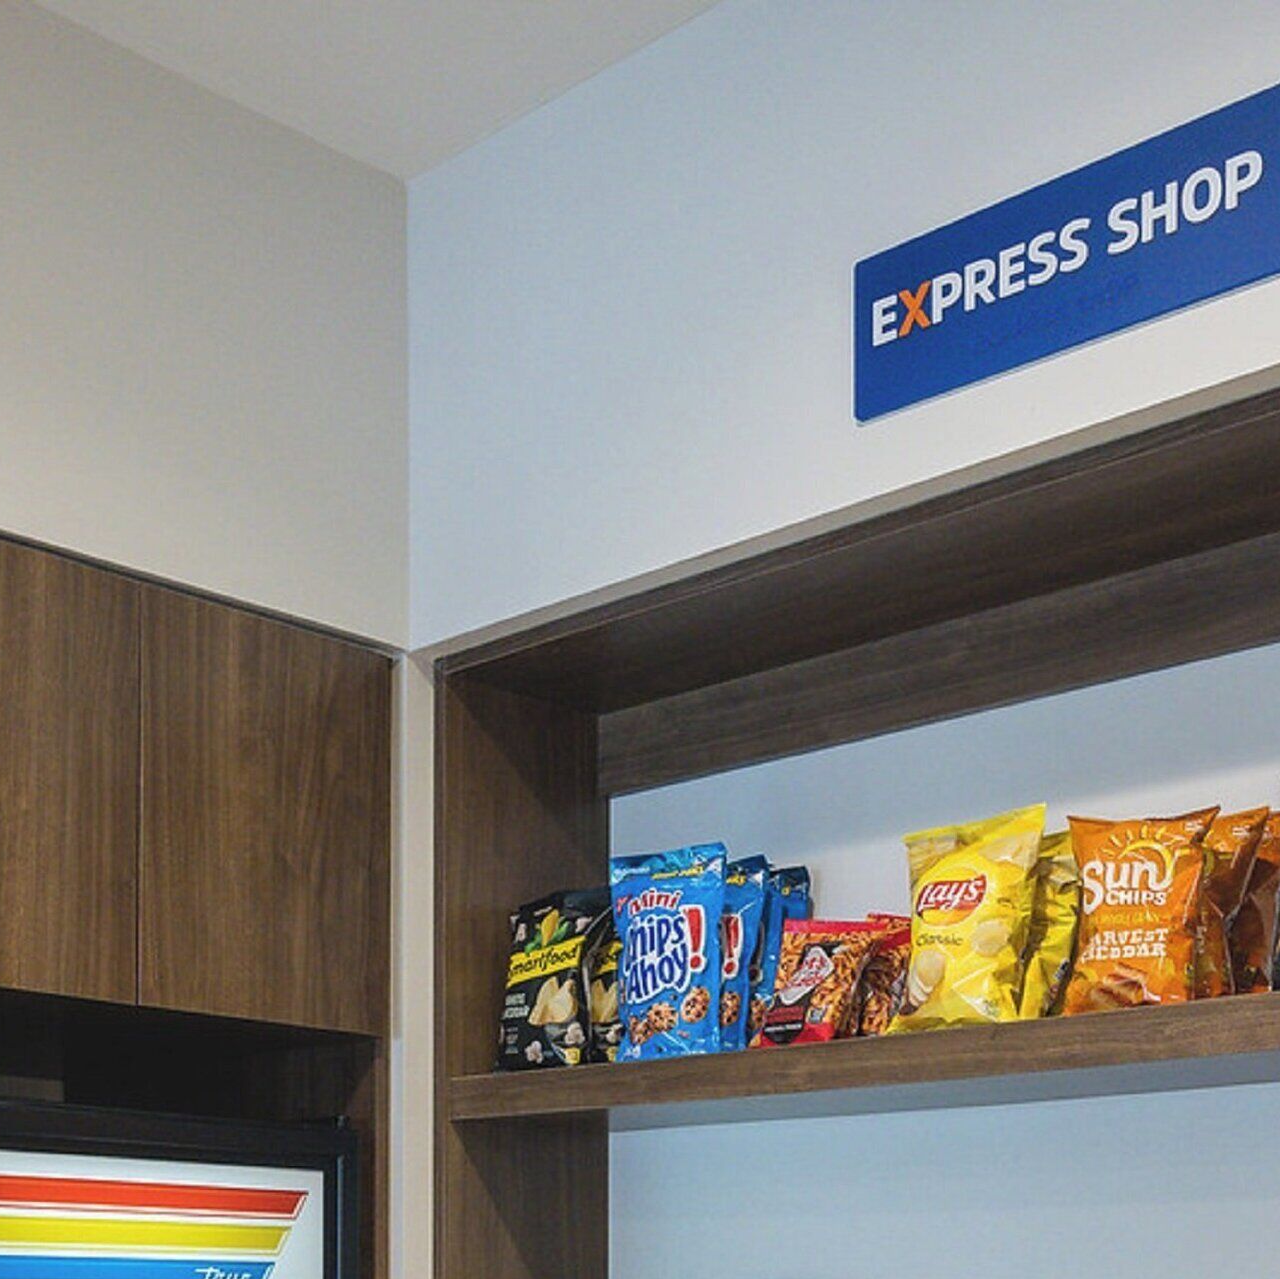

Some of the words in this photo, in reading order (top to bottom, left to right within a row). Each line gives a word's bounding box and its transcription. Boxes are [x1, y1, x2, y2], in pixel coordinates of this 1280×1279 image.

[872, 218, 1091, 347] EXPRESS
[1107, 150, 1264, 255] SHOP
[1083, 860, 1173, 915] Sun
[1105, 890, 1167, 906] CHIPS
